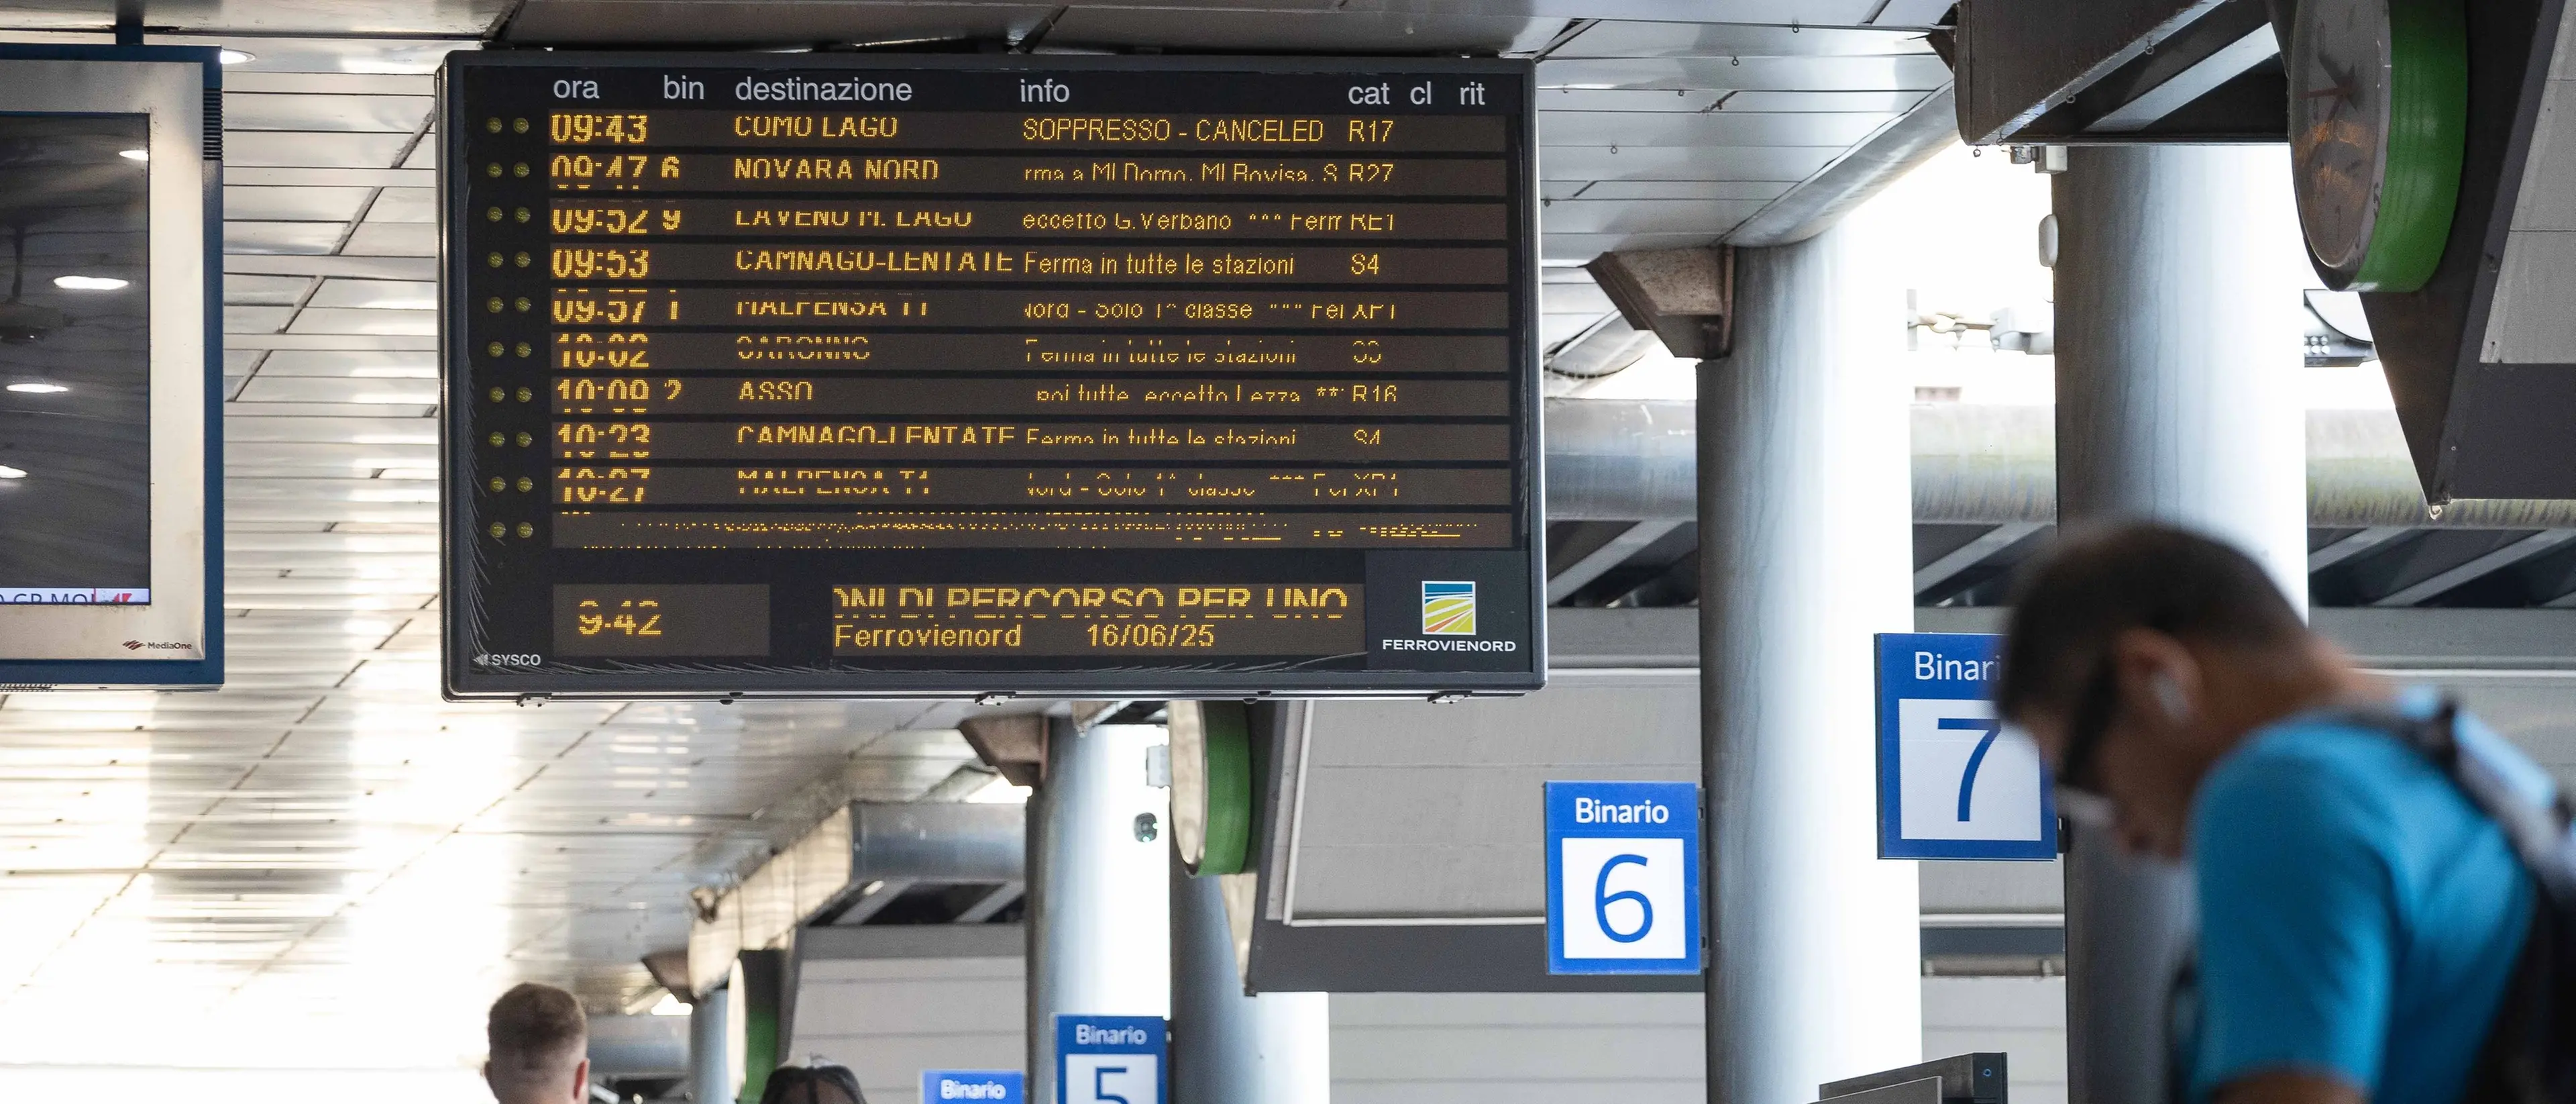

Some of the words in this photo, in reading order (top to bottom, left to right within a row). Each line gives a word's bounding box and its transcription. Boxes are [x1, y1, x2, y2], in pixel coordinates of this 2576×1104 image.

[553, 79, 600, 99] ora
[663, 74, 704, 100] bin
[735, 77, 913, 101] destinazione
[1020, 79, 1070, 103] info
[1348, 83, 1390, 105] cat
[1410, 81, 1432, 105] cl
[1460, 81, 1485, 105] rit
[552, 114, 647, 143] 09:43
[735, 116, 812, 138] COMO
[823, 117, 898, 138] LAGO
[1023, 118, 1171, 141] SOPPRESSO
[1196, 119, 1324, 142] CANCELED
[1349, 120, 1394, 142] R17
[735, 158, 853, 179] NOVARA
[866, 159, 938, 180] NORD
[1349, 164, 1394, 182] R27
[553, 209, 648, 234] 09:52
[737, 210, 849, 226] LAVENO
[897, 211, 971, 227] LAGO
[1023, 213, 1106, 230] eccetto
[1350, 214, 1394, 231] RE1
[553, 249, 649, 279] 09:53
[737, 250, 1013, 271] CAMNAGO-LENTATE
[1024, 252, 1093, 274] Ferma
[1102, 253, 1117, 274] in
[1126, 253, 1177, 274] tutte
[1186, 252, 1203, 274] le
[1212, 253, 1294, 274] stazioni
[1351, 253, 1379, 274] S4
[1185, 303, 1252, 319] classe
[739, 381, 812, 400] ASSO
[148, 642, 193, 650] MediaOne
[835, 624, 1021, 648] Ferrovienord
[1087, 624, 1215, 648] 16/06/25
[1383, 640, 1516, 652] FERROVIENORD
[492, 654, 541, 666] SYSCO
[1914, 650, 2001, 681] Binari
[1937, 717, 2003, 822] 7
[1575, 797, 1669, 824] Binario
[1595, 853, 1654, 944] 6
[1075, 1023, 1148, 1046] Binario
[941, 1078, 1007, 1100] Binario
[1095, 1066, 1130, 1104] 5
